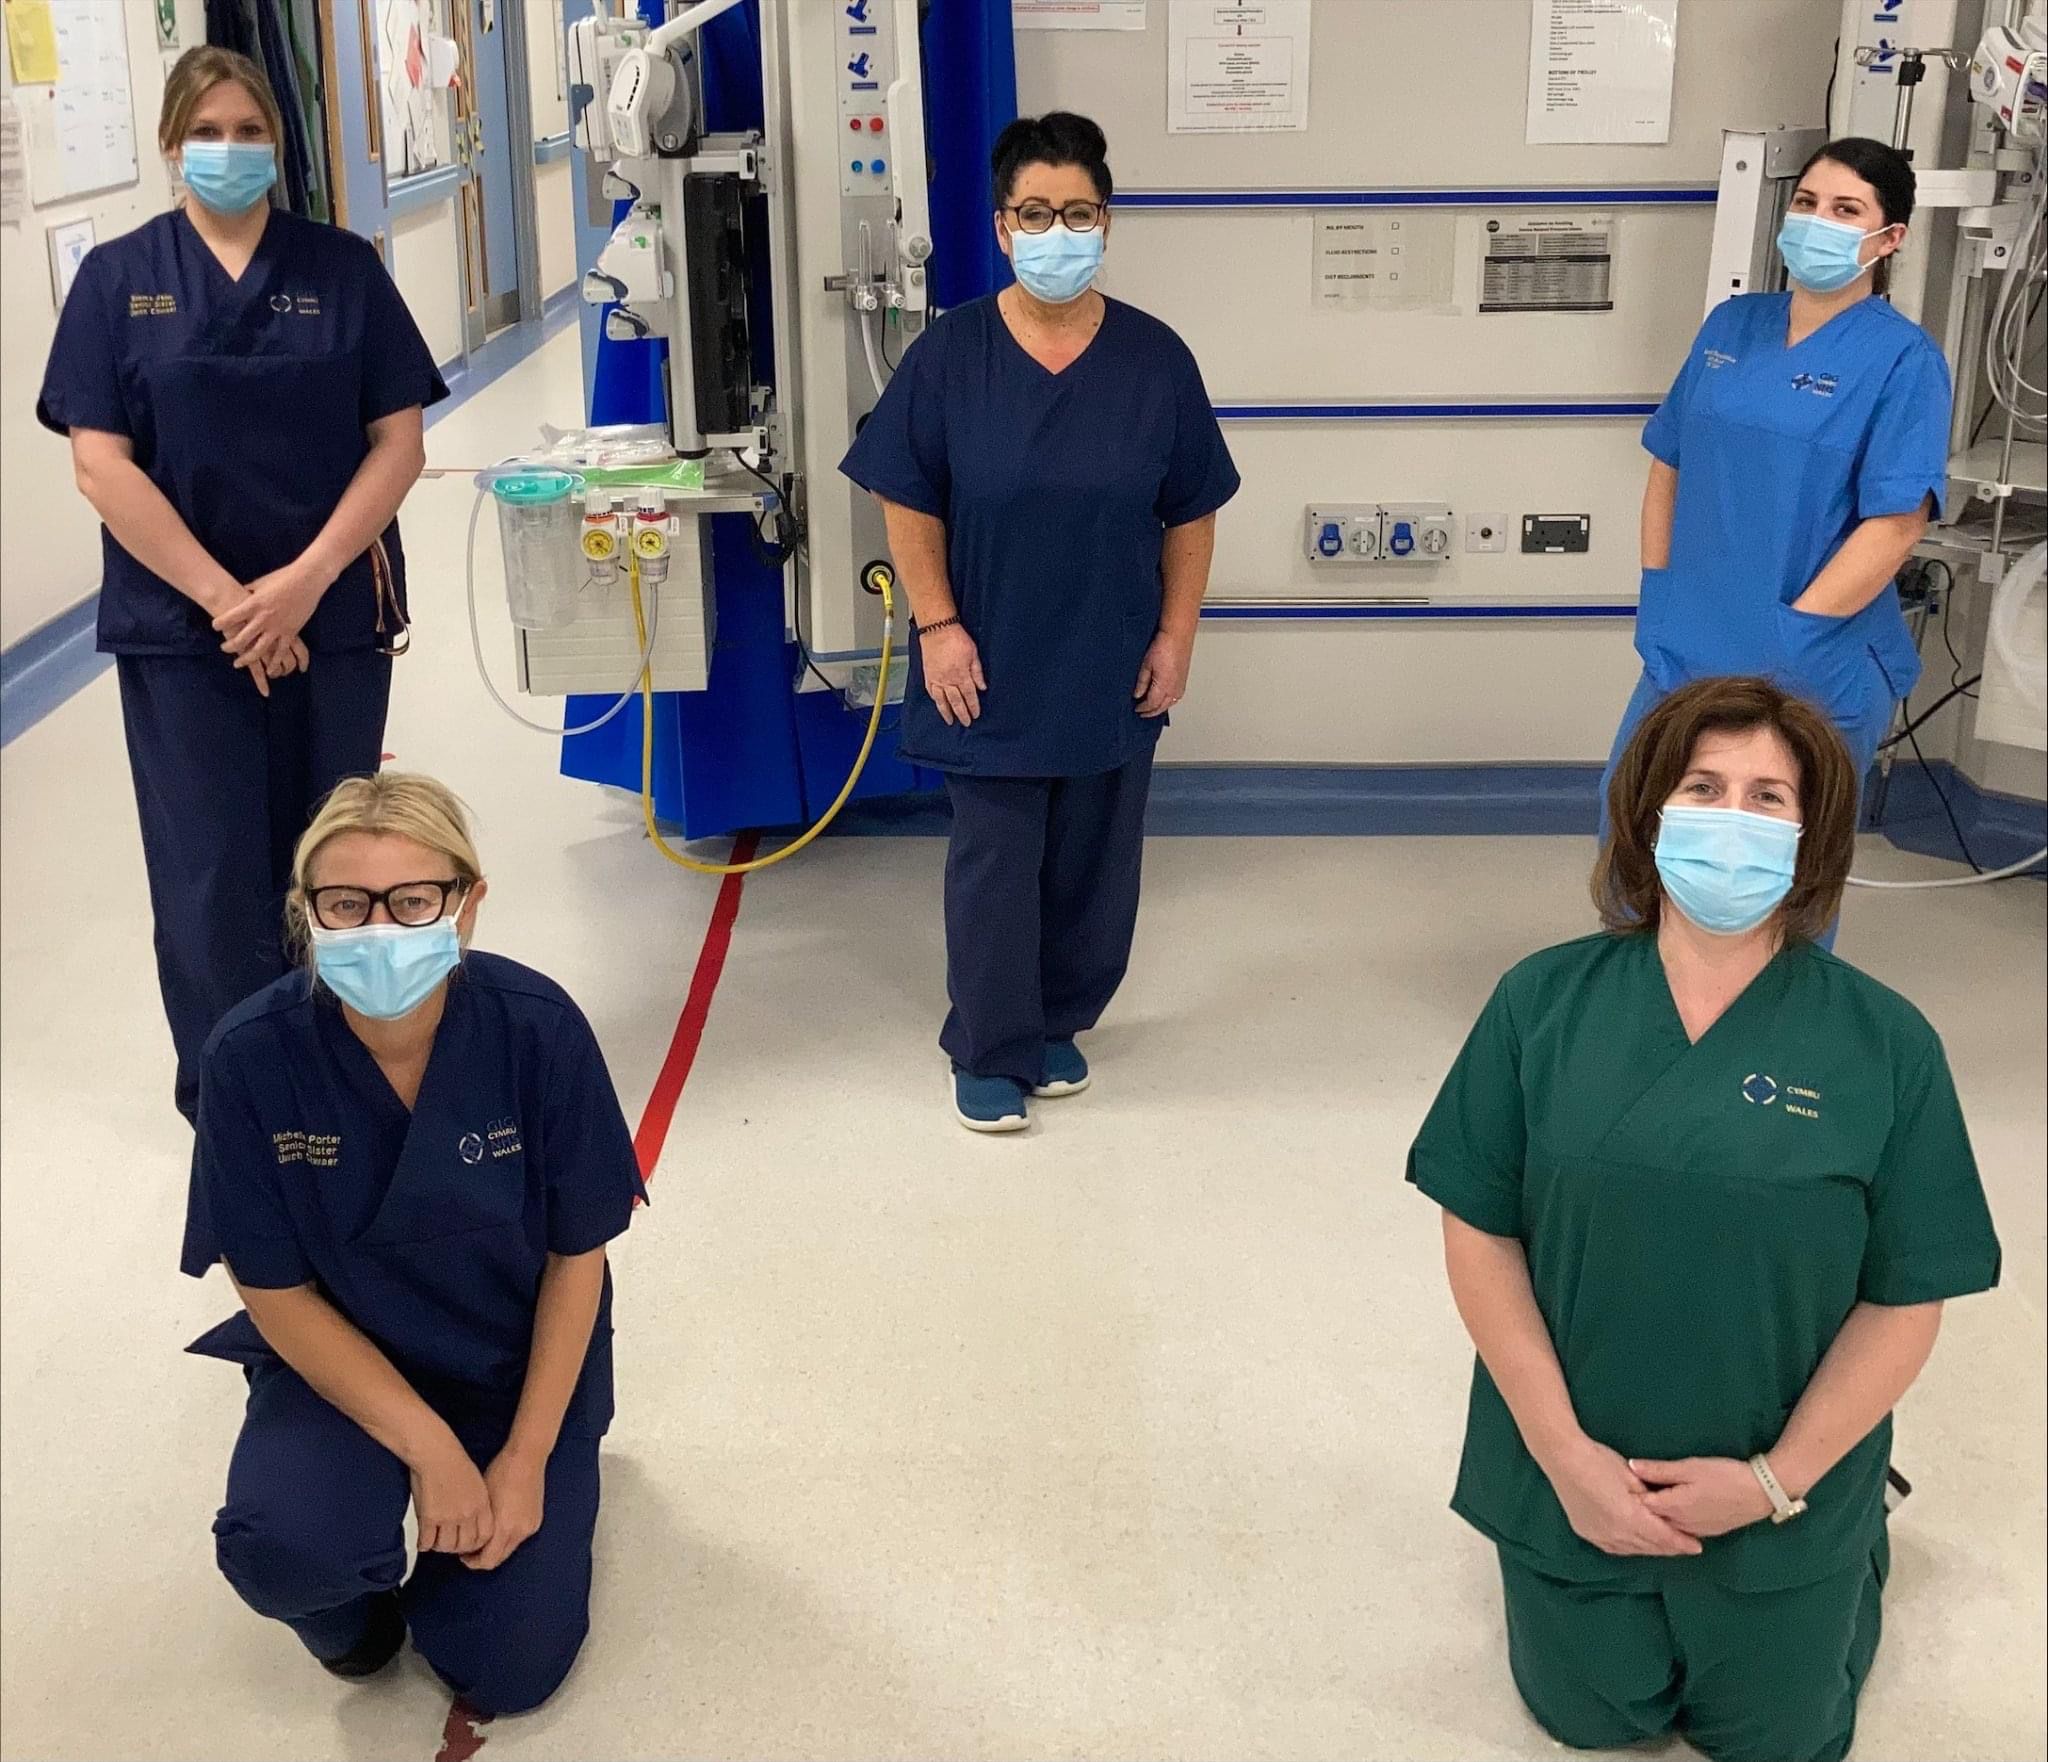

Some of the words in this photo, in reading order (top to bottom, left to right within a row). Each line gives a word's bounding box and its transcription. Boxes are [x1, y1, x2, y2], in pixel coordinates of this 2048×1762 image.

[1786, 1086, 1821, 1100] CYMRU
[1785, 1103, 1819, 1119] WALES
[487, 1116, 514, 1131] GIG
[308, 1134, 341, 1145] Porter
[488, 1127, 517, 1140] CYMRU
[279, 1141, 306, 1153] Senio
[492, 1143, 522, 1158] WALES
